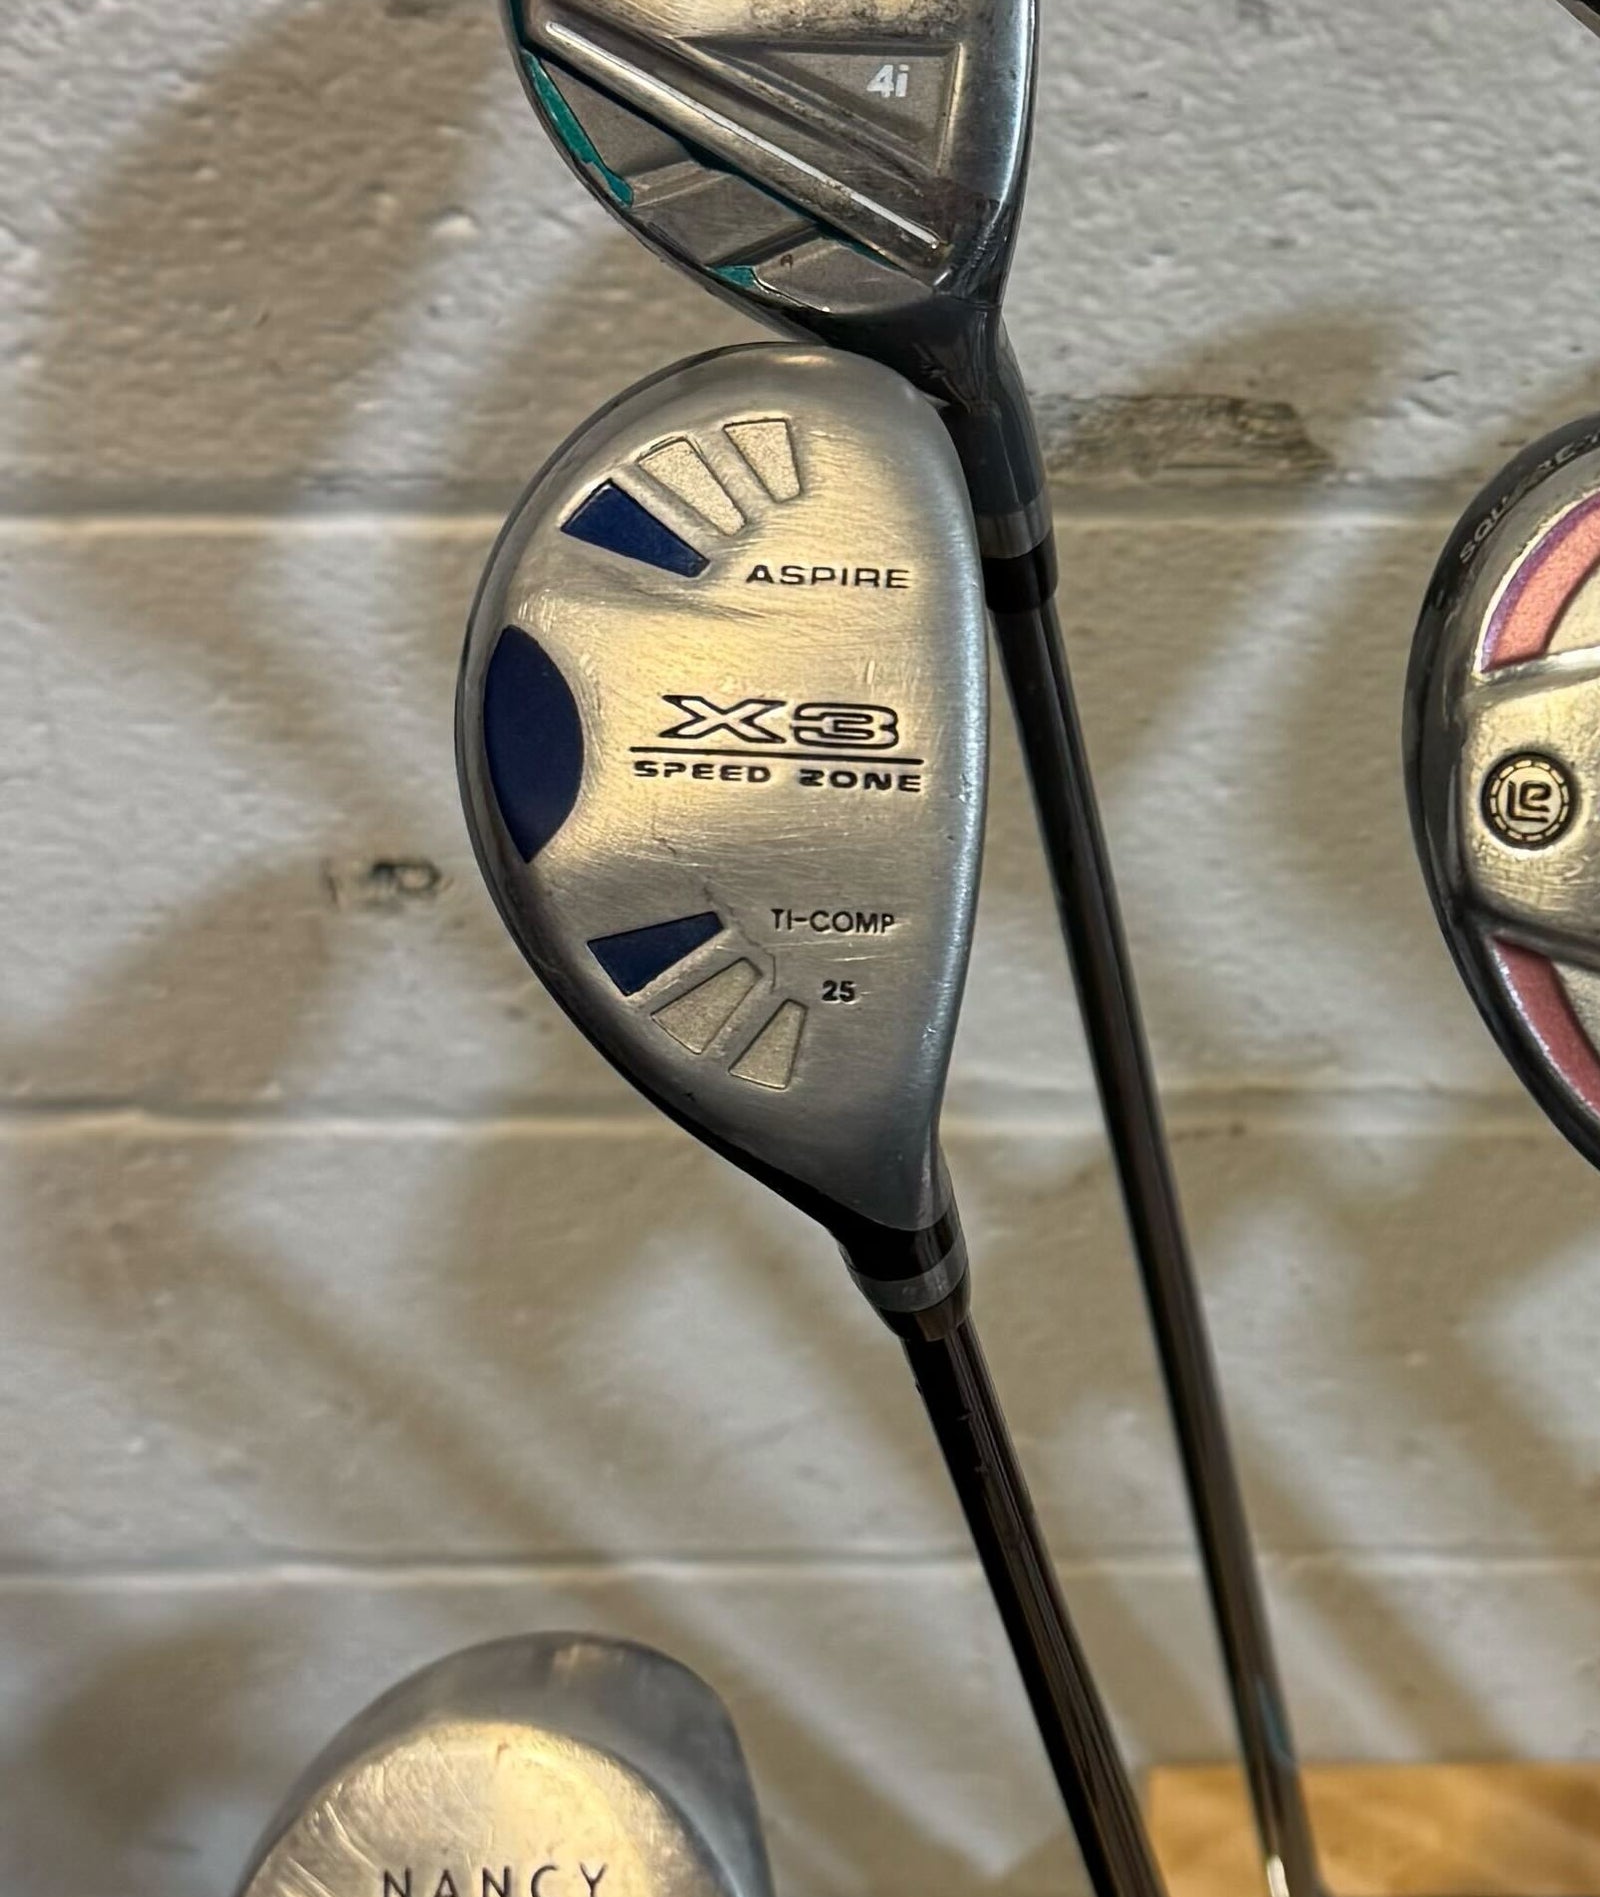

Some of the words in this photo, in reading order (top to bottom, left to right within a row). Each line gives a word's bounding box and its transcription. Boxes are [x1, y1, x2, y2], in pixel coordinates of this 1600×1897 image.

[866, 64, 910, 98] 4i
[745, 564, 911, 590] ASPIRE
[658, 694, 901, 751] X3
[633, 759, 772, 785] SPEED
[798, 767, 923, 794] ZONE
[770, 907, 897, 935] TI-COMP
[821, 979, 857, 1004] 25
